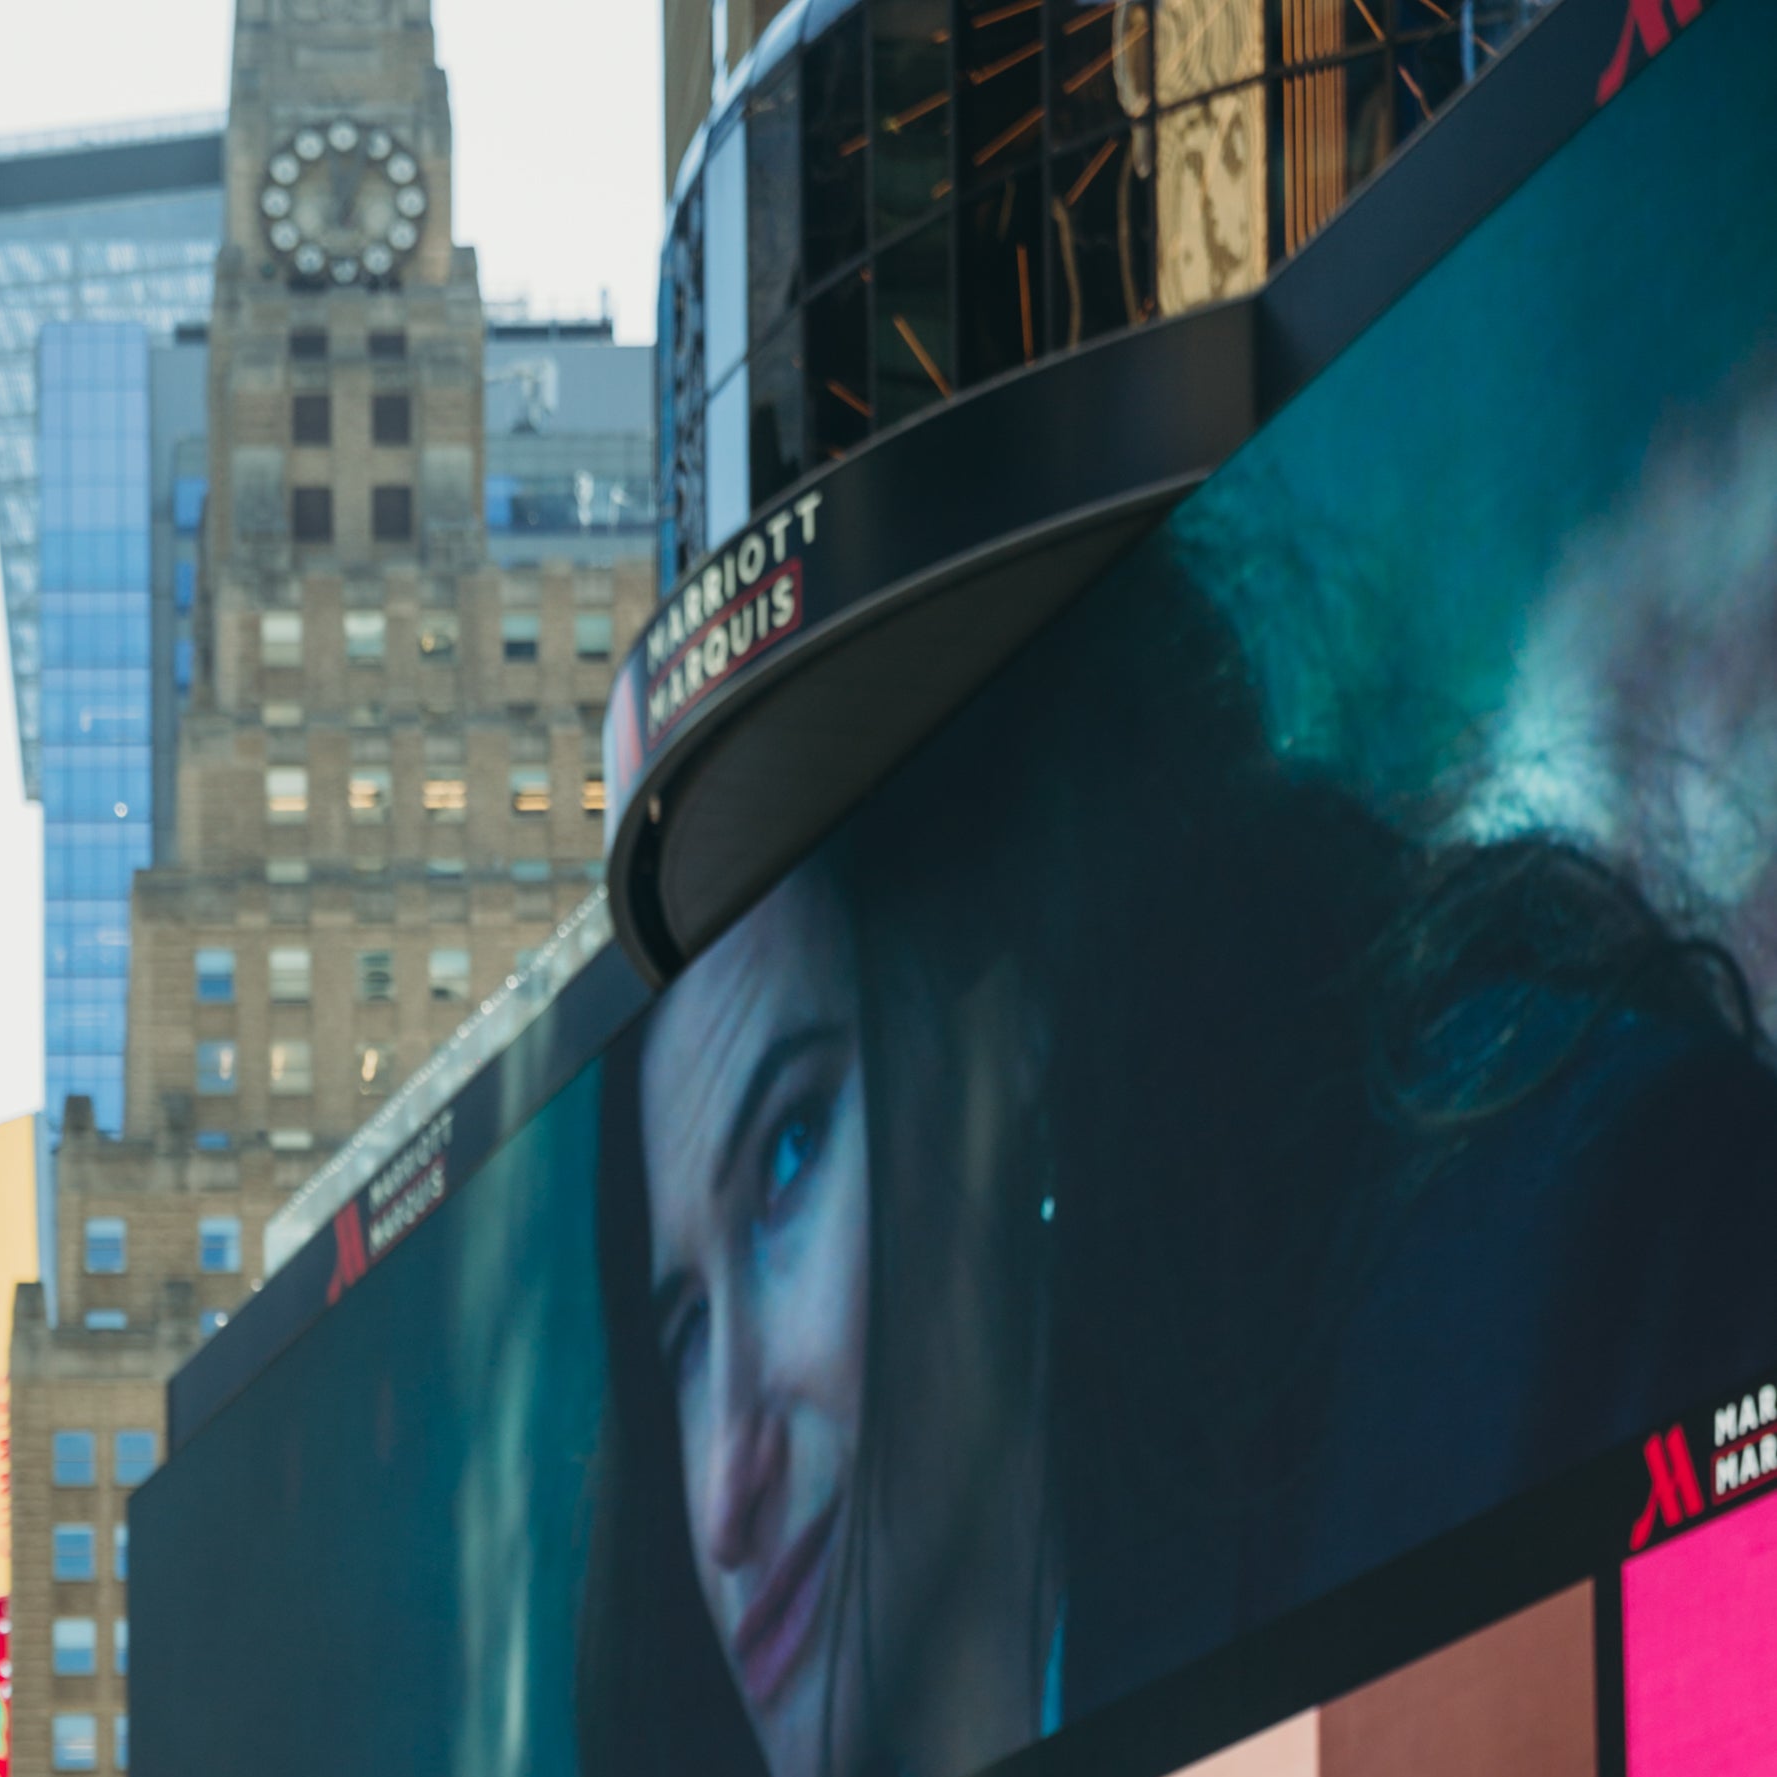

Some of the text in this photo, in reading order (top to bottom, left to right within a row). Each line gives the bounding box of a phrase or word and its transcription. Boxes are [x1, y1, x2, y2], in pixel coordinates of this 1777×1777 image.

[647, 489, 822, 675] MARRIOTT
[648, 574, 796, 738] MARQUIS
[369, 1109, 454, 1214] MARRIOTT
[369, 1161, 445, 1257] MARQUIS
